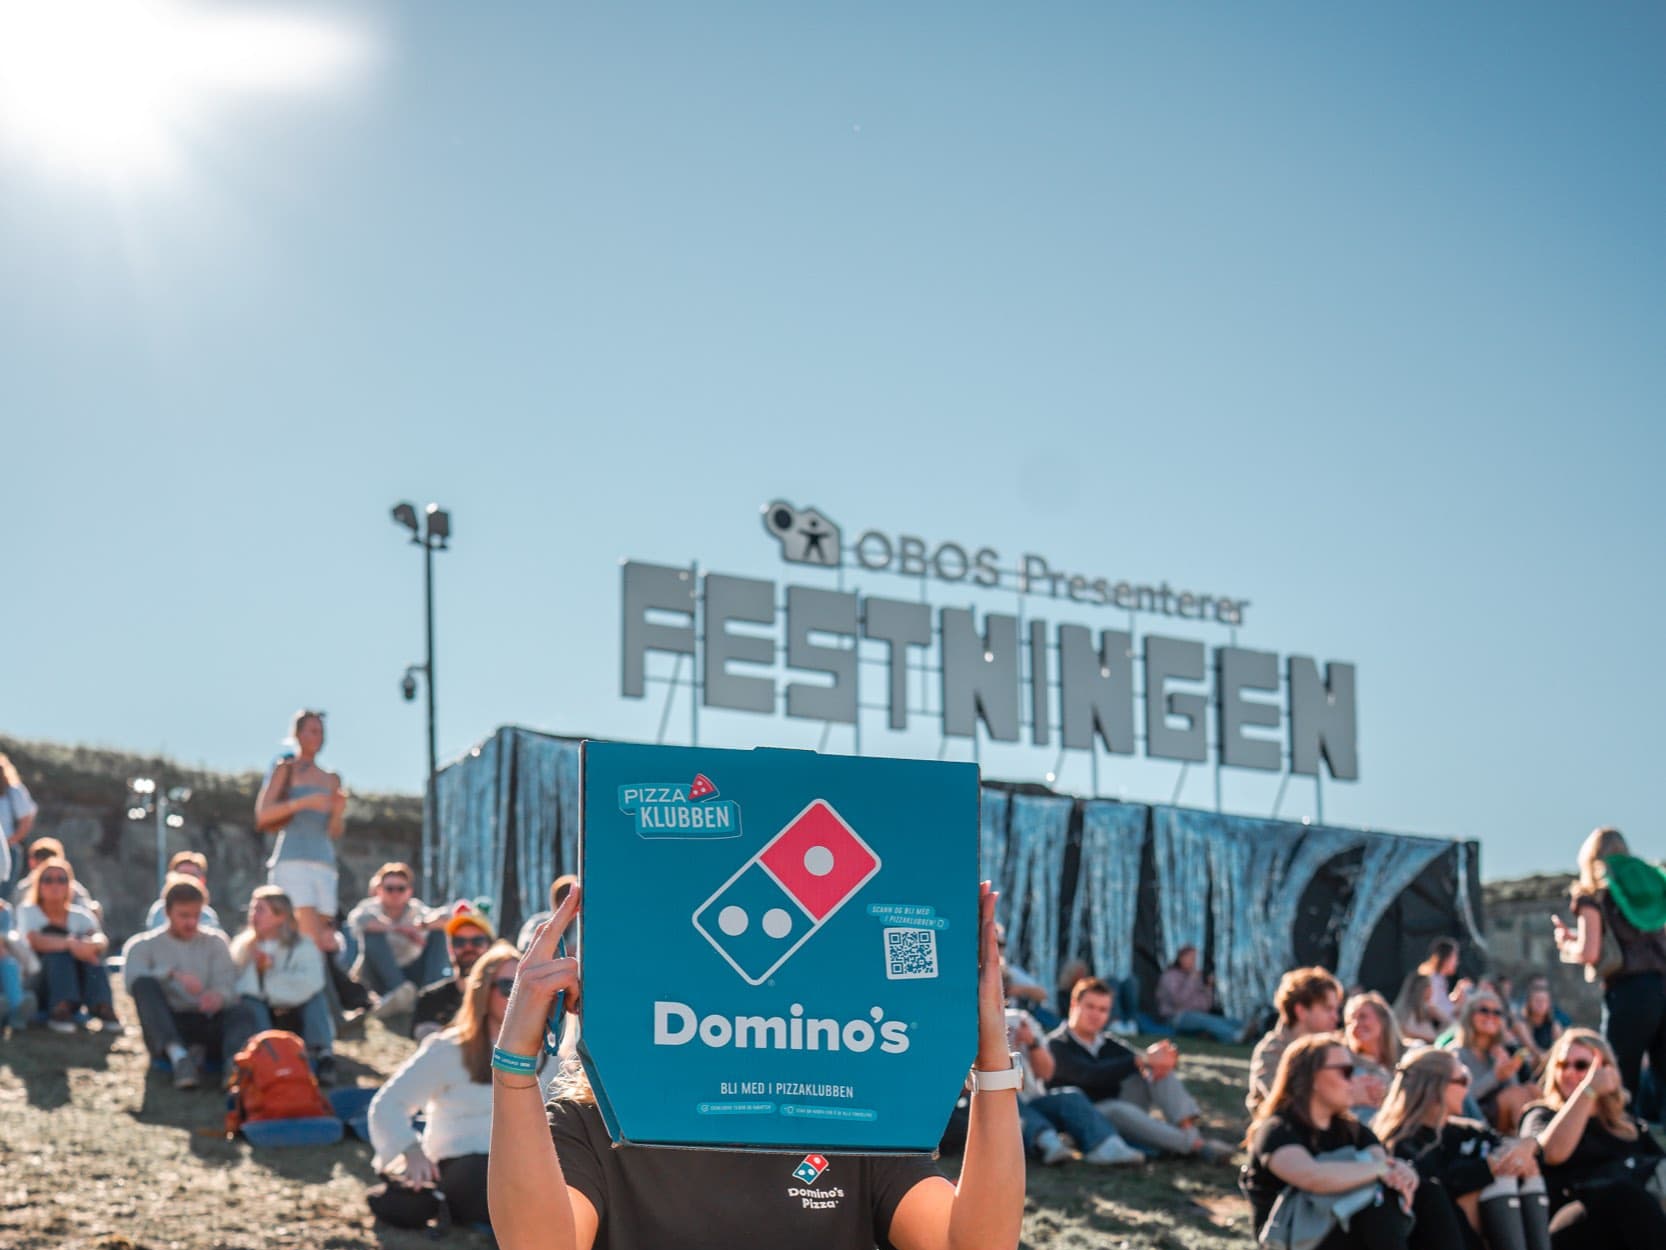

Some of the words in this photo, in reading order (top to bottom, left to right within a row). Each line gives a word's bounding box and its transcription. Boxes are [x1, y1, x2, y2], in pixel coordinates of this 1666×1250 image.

[855, 530, 999, 587] OBOS
[1020, 552, 1250, 627] Presenterer
[621, 560, 1358, 781] FESTNINGEN
[624, 788, 687, 804] PIZZA
[641, 806, 730, 828] KLUBBEN
[654, 1001, 910, 1054] Domino's
[720, 1082, 737, 1095] BLI
[741, 1082, 765, 1095] MED
[768, 1083, 773, 1095] I
[776, 1083, 854, 1098] PIZZAKLUBBEN
[787, 1187, 845, 1199] Domino's
[802, 1198, 836, 1209] Pizza
